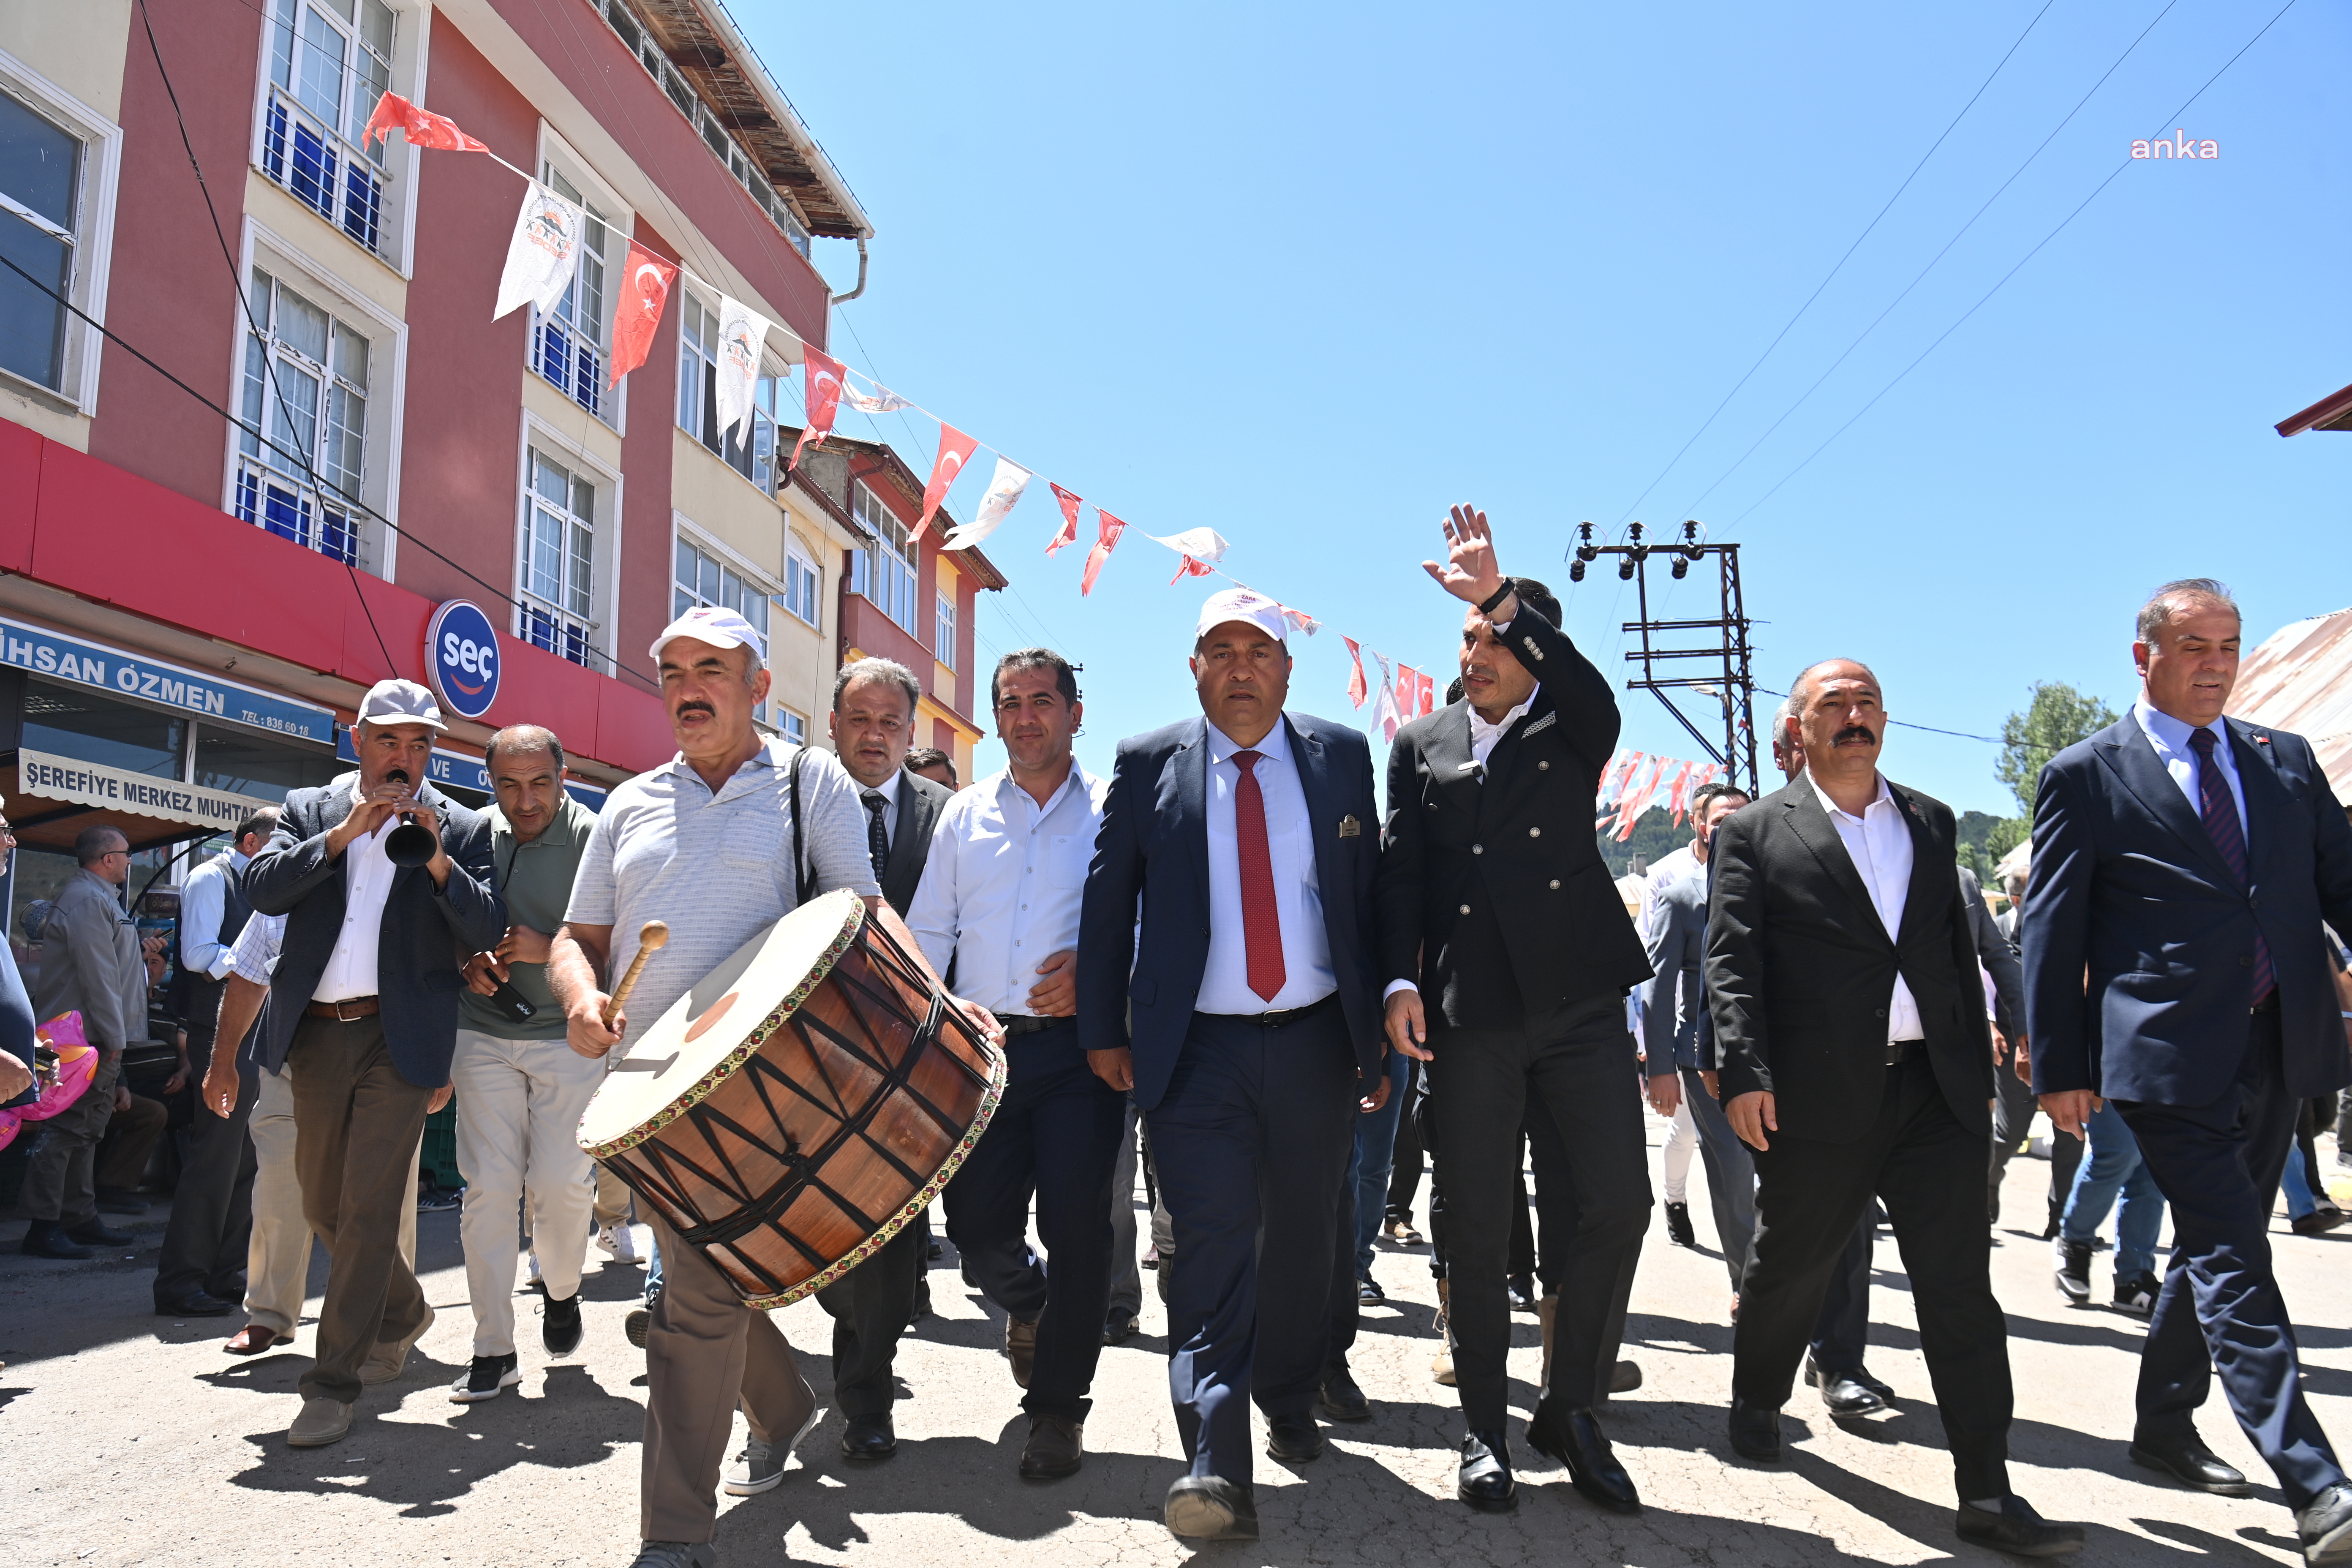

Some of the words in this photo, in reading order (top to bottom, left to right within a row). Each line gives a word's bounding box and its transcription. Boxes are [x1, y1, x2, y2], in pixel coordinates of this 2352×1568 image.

[0, 627, 105, 684] İHSAN
[444, 632, 493, 682] seç
[267, 716, 283, 730] 836
[285, 721, 296, 733] 60
[299, 725, 309, 736] 18
[27, 762, 117, 798] ŞEREFİYE
[124, 782, 192, 813] MERKEZ
[432, 758, 450, 779] VE
